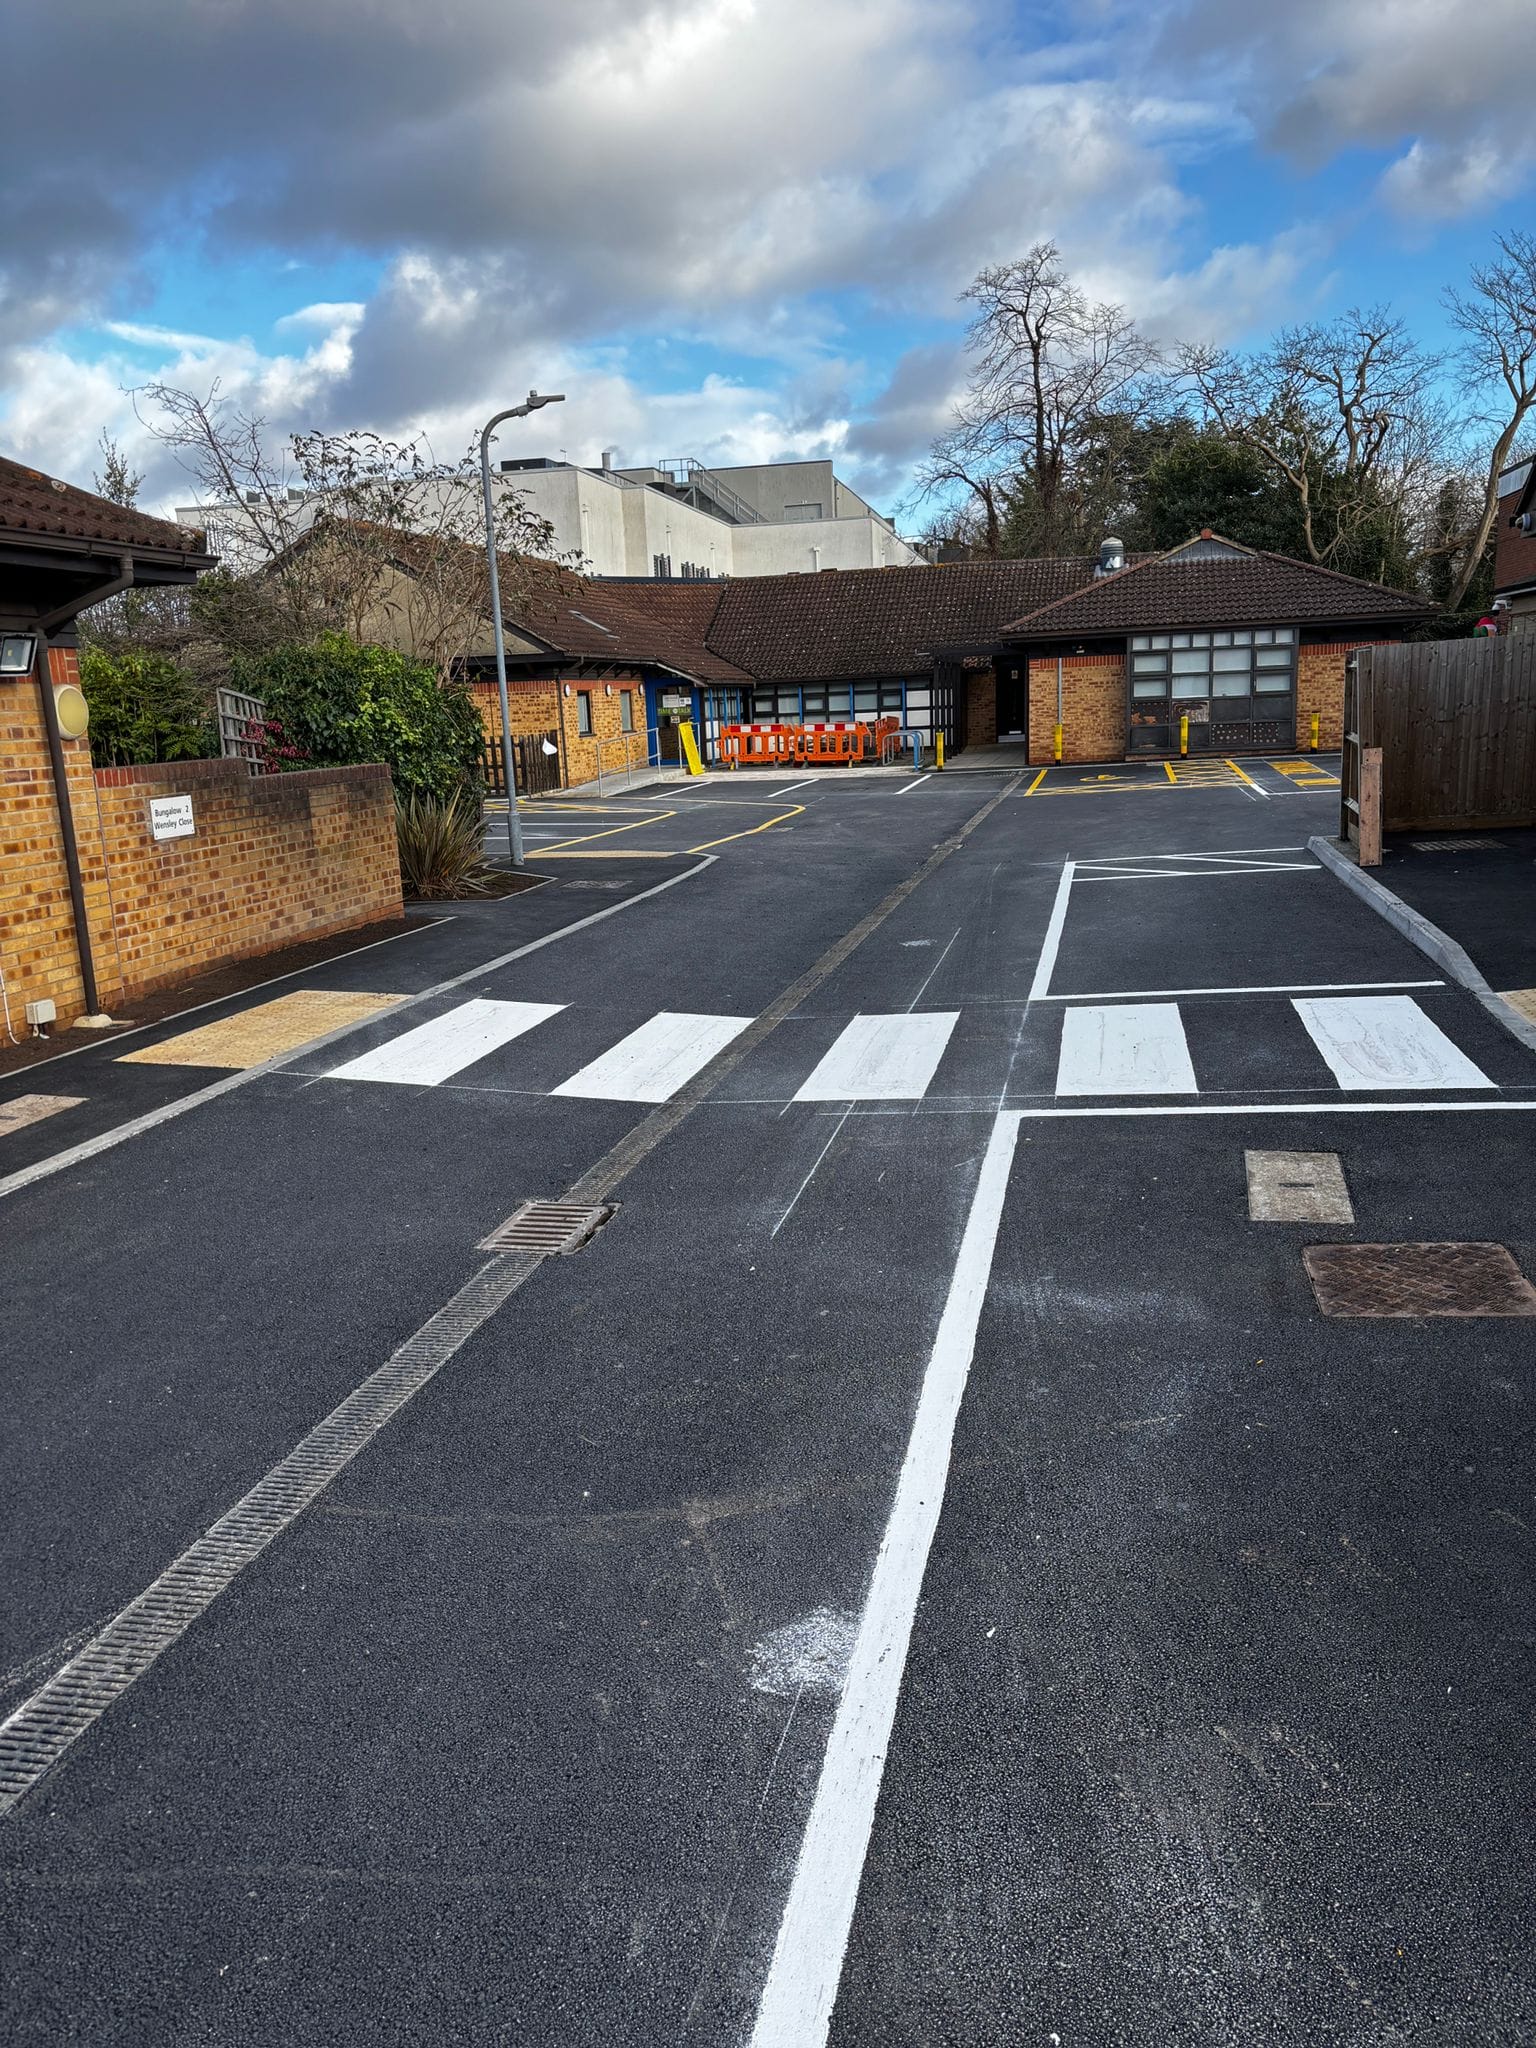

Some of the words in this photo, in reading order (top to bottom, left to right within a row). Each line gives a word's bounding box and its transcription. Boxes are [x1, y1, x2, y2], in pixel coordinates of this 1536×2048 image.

[154, 807, 182, 817] Bungalow
[185, 805, 189, 813] 2
[154, 819, 177, 830] Wensley
[178, 817, 192, 826] Close
